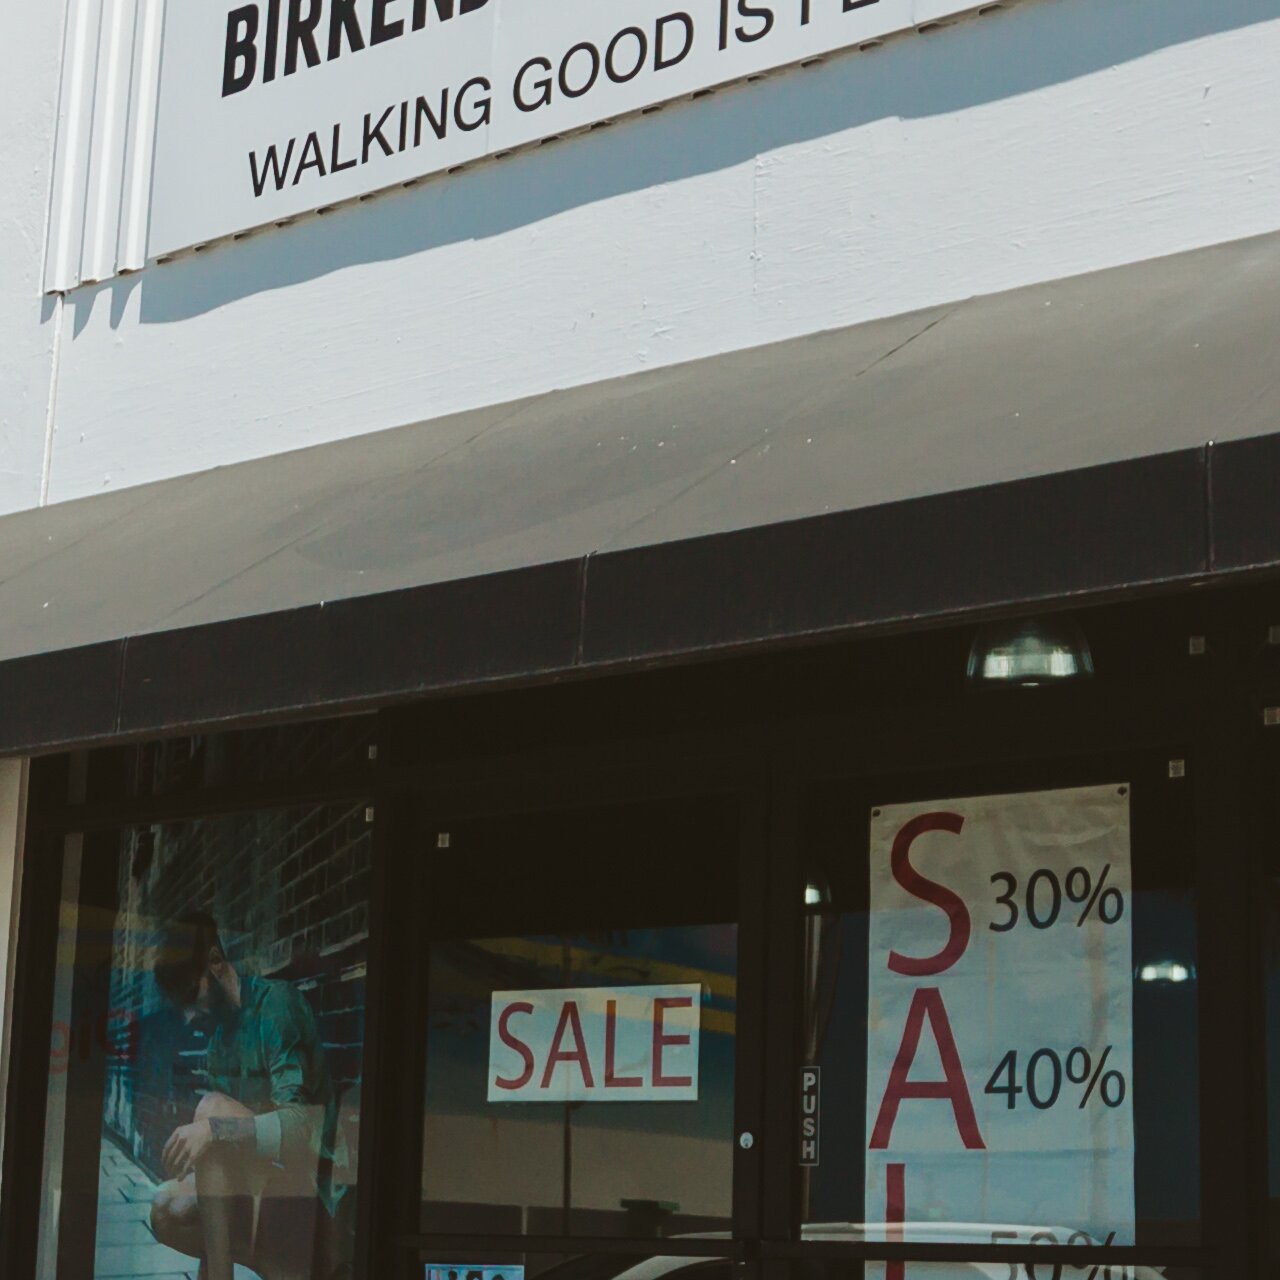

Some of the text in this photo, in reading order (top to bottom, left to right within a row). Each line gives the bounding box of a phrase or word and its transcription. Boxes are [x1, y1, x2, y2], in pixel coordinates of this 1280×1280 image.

[247, 74, 492, 198] WALKING
[513, 10, 697, 111] GOOD
[987, 863, 1125, 933] 30%
[494, 996, 693, 1091] SALE
[984, 1045, 1126, 1111] 40%
[802, 1072, 816, 1159] PUSH
